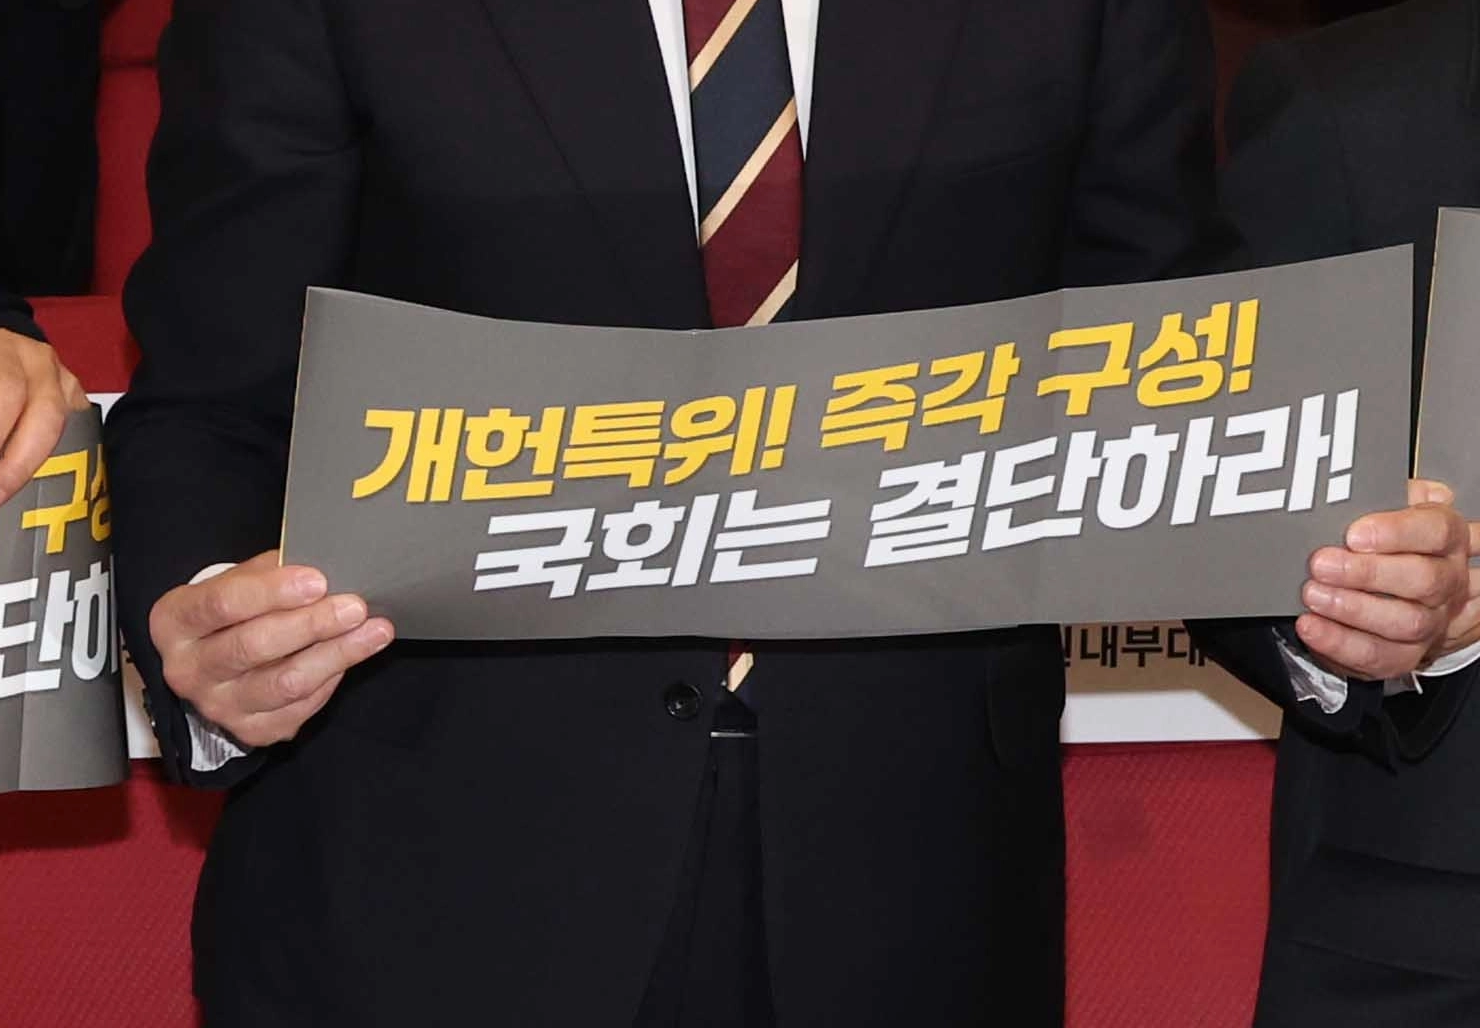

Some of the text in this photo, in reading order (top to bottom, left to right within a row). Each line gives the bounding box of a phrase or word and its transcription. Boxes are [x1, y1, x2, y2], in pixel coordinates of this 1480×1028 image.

[351, 298, 1260, 504] 개헌특위! 즉각 구성!
[472, 388, 1361, 600] 국회는 결단하라!
